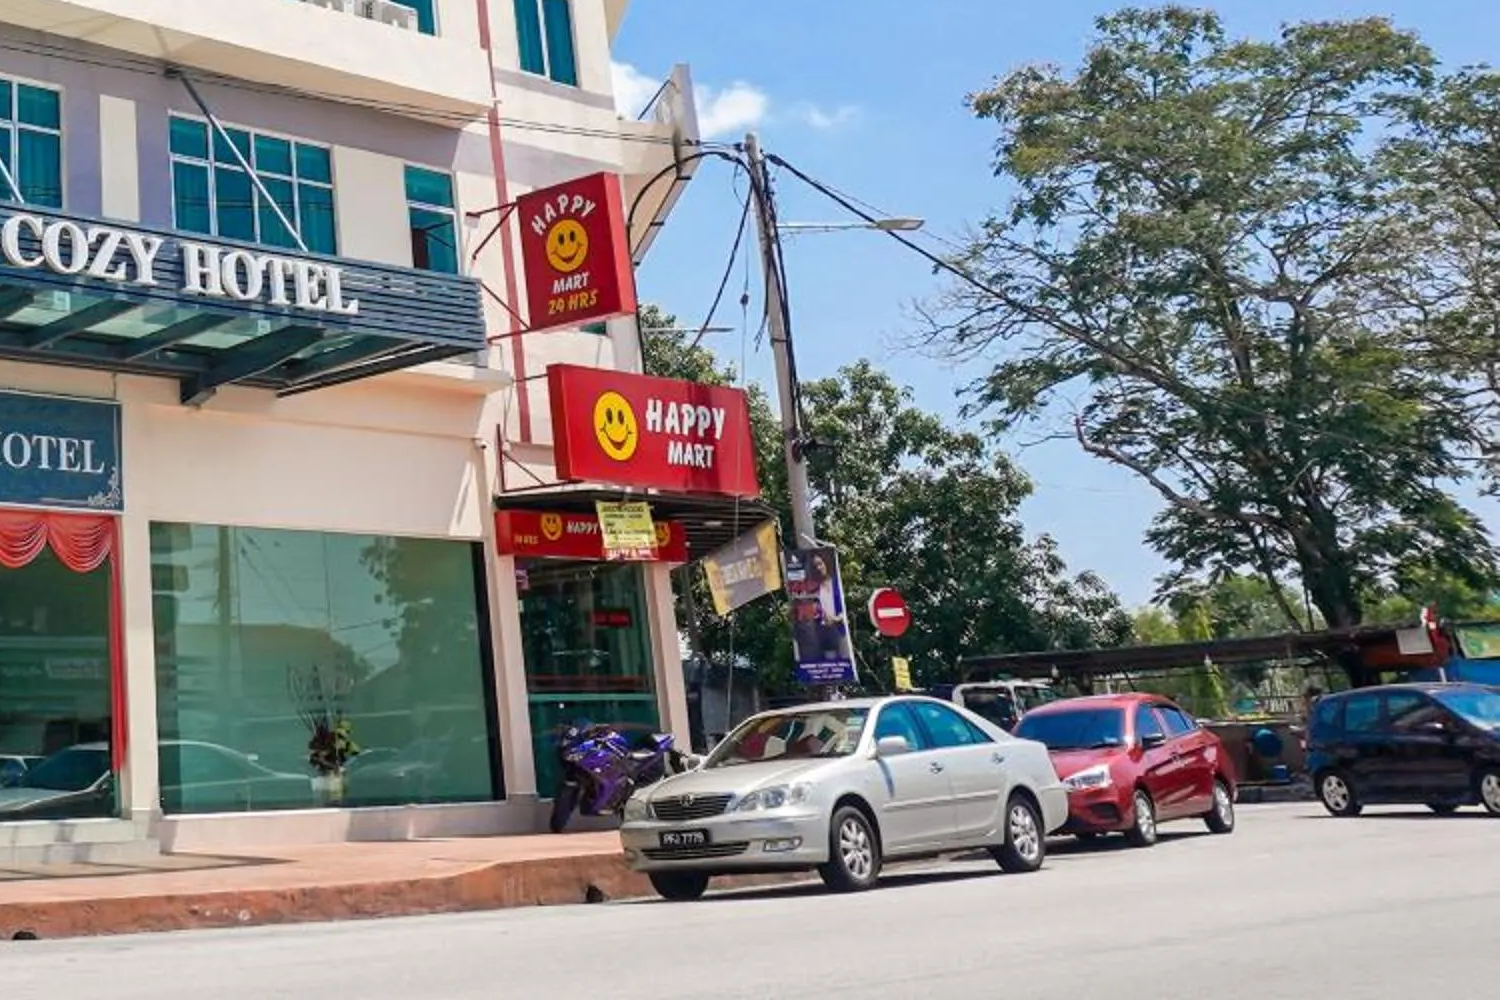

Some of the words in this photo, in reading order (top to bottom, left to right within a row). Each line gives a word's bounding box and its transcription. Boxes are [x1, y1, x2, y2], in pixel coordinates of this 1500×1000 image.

[531, 193, 596, 236] HAPPY
[1, 214, 164, 286] COZY
[178, 241, 360, 314] HOTEL
[552, 271, 590, 294] MART
[547, 296, 565, 316] 24
[568, 288, 599, 311] HRS
[645, 398, 726, 440] HAPPY
[667, 440, 715, 469] MART
[565, 519, 599, 535] HAPPY
